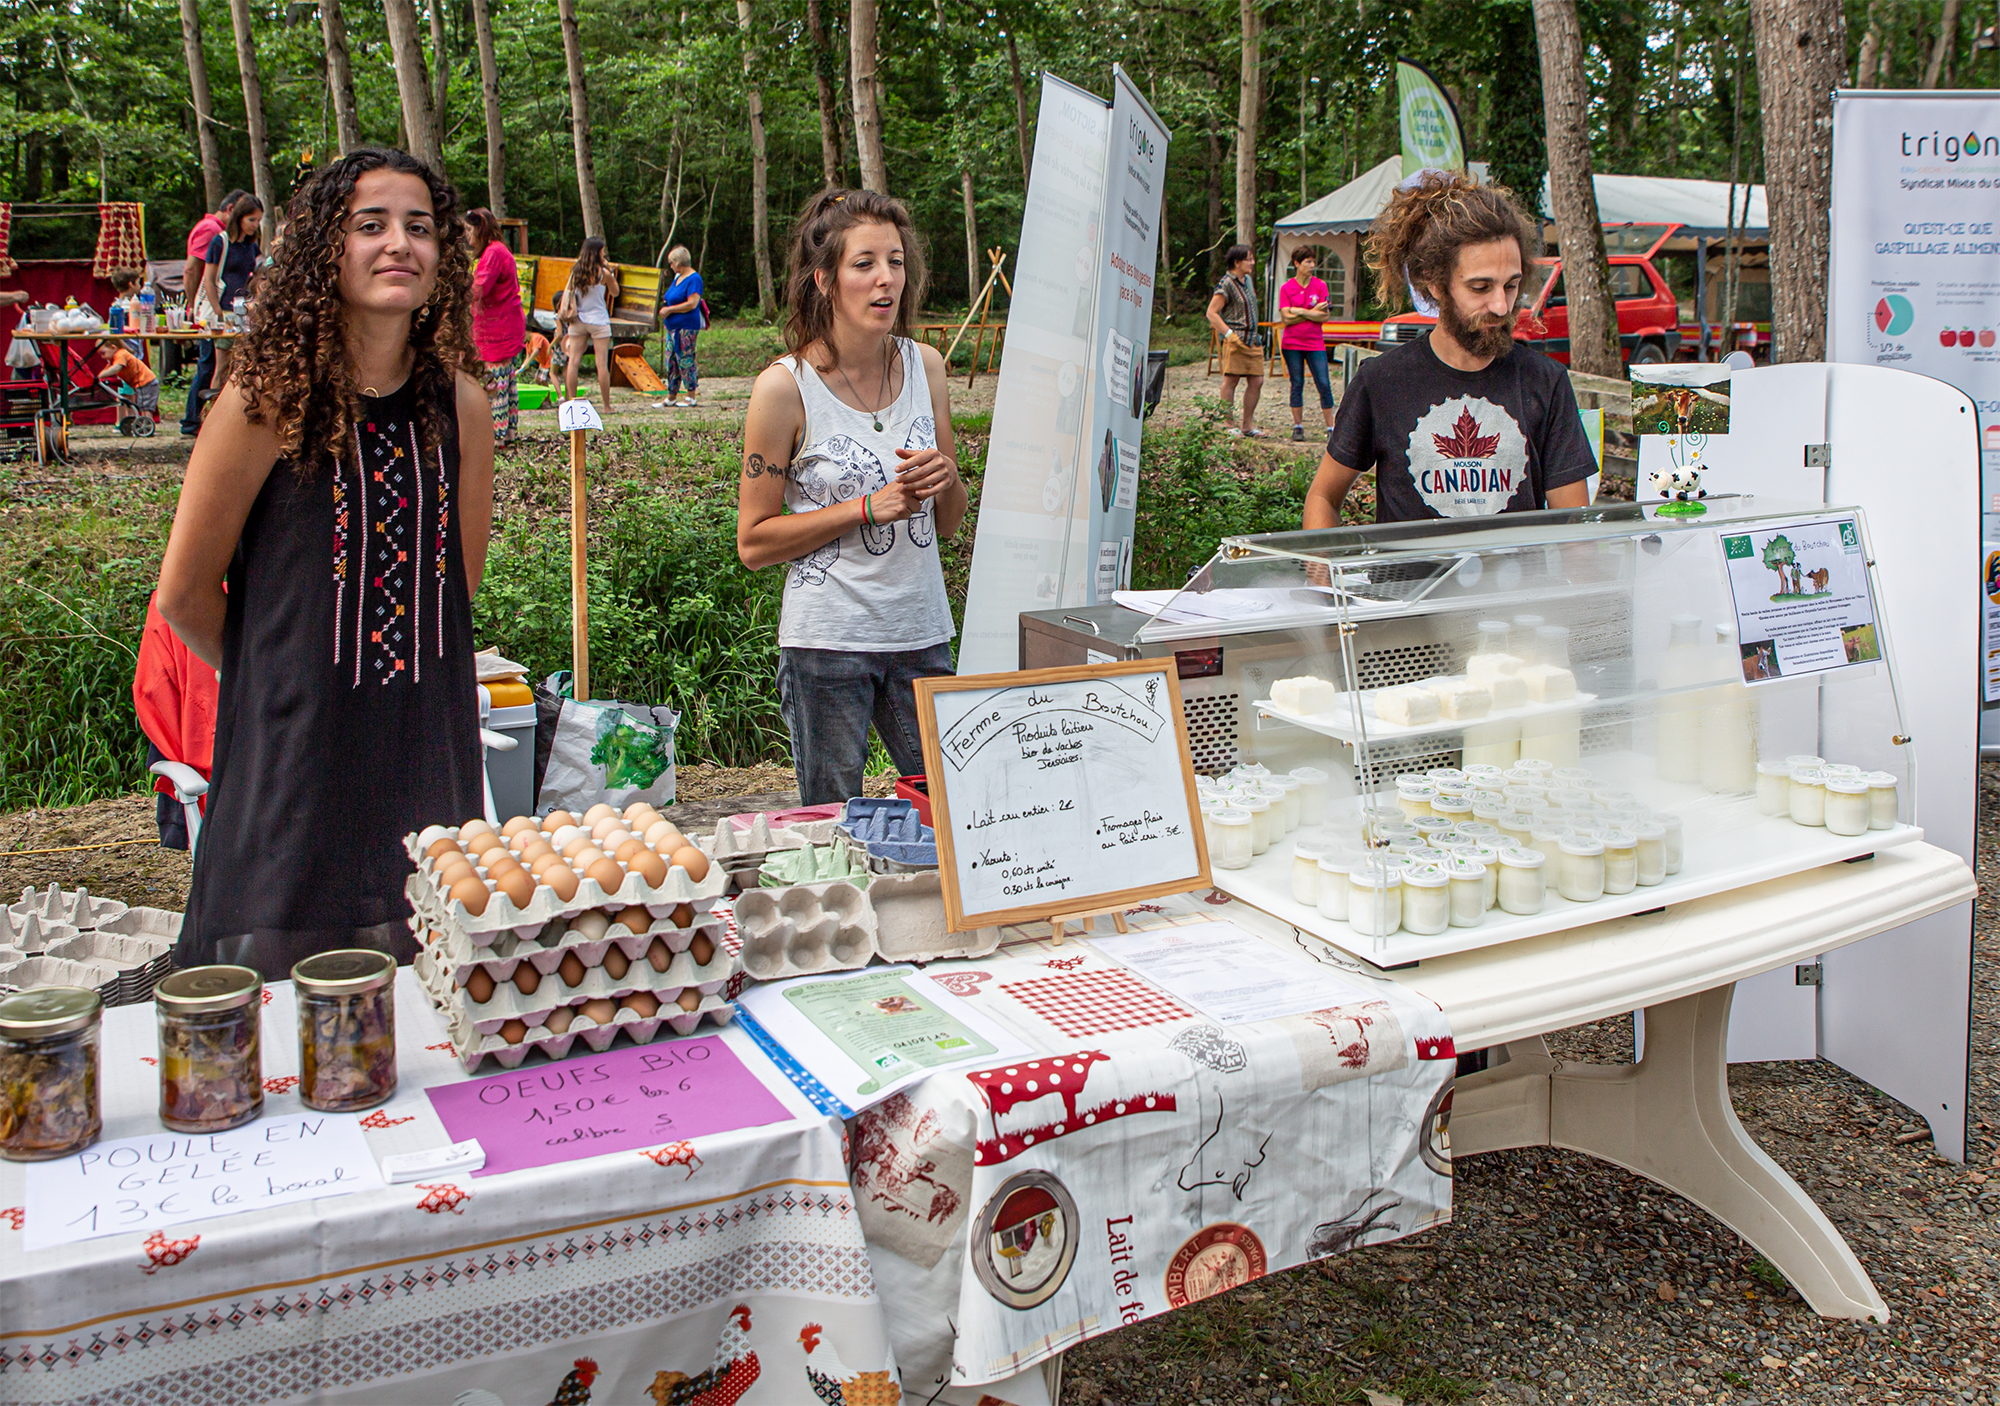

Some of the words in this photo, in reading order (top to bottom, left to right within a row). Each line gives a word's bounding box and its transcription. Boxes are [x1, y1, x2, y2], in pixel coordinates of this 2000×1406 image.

[1969, 223, 1993, 235] QUE
[1875, 242, 1949, 254] GASPILLAGE
[566, 405, 591, 425] 13
[1421, 468, 1511, 494] CANADIAN
[946, 711, 1001, 759] Ferme
[1028, 690, 1054, 707] du
[1012, 723, 1058, 744] Produits
[1062, 718, 1094, 736] laitiers
[1021, 747, 1038, 759] bio
[1042, 742, 1053, 755] de
[1055, 739, 1083, 751] vaches
[973, 809, 996, 828] Lait
[999, 813, 1020, 822] cru
[1059, 799, 1075, 811] 2€
[1100, 816, 1142, 835] Fromages
[1119, 832, 1137, 845] lait
[979, 848, 1011, 867] Yaourts
[479, 1064, 610, 1105] OEUFS
[639, 1045, 711, 1074] BIO
[524, 1095, 629, 1125] 1,50€
[639, 1084, 669, 1099] les
[679, 1077, 691, 1092] 6
[78, 1135, 231, 1175] POULE
[266, 1118, 325, 1144] EN
[546, 1127, 626, 1146] calibre
[118, 1150, 276, 1190] GELÉE
[66, 1193, 189, 1231] 13€
[212, 1185, 243, 1205] le
[262, 1167, 360, 1198] bocal
[1106, 1214, 1133, 1265] Lait
[1240, 1233, 1262, 1272] ALPAGES
[1113, 1269, 1139, 1297] de
